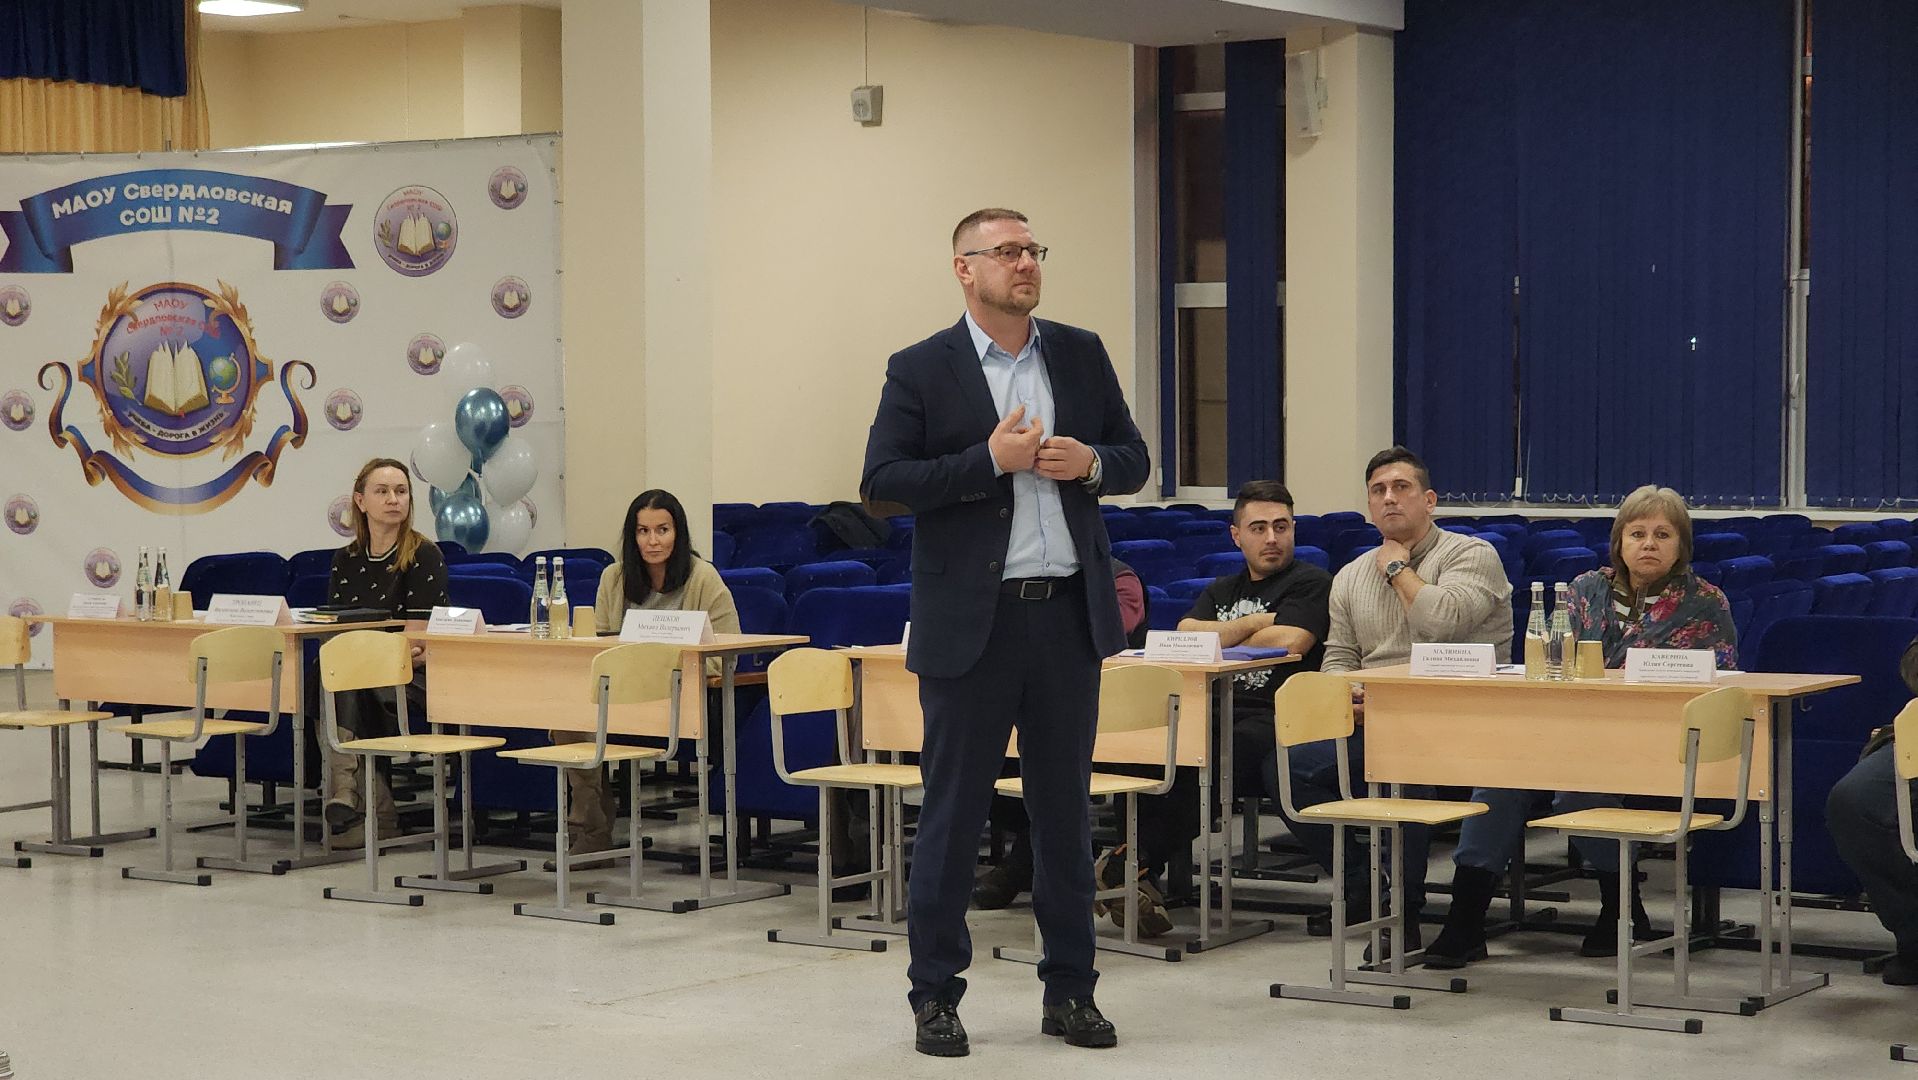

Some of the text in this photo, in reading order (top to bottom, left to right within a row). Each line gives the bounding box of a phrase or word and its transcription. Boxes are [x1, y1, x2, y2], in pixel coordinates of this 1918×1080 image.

[52, 183, 294, 219] МАОУ Свердловская
[119, 206, 220, 226] СОШ №2
[153, 298, 188, 311] МАОУ
[157, 430, 190, 440] ДОРОГА
[198, 412, 224, 434] ЖИЗНЬ
